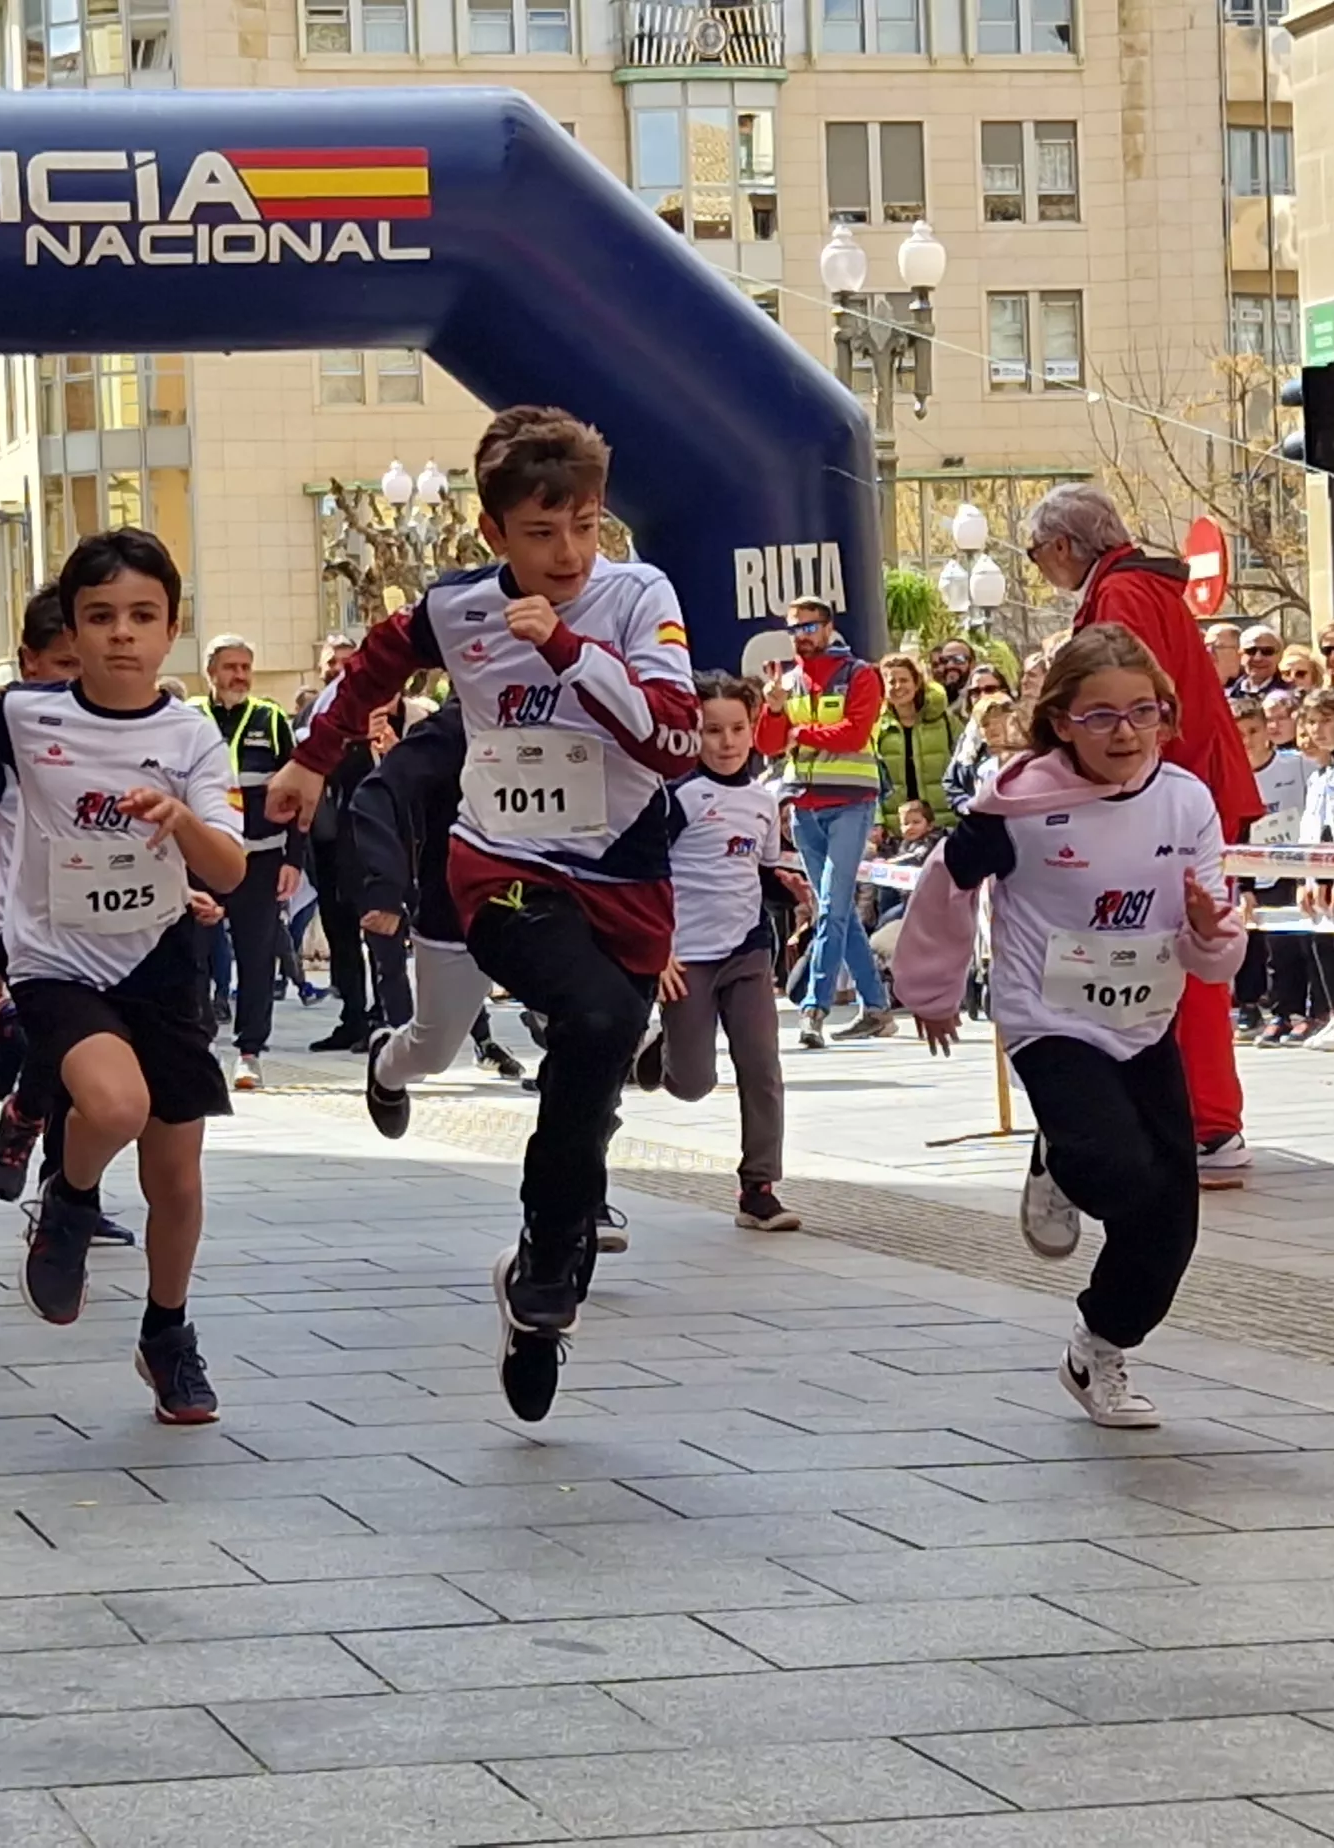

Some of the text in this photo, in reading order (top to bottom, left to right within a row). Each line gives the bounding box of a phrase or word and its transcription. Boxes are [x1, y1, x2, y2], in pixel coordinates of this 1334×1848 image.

[25, 219, 432, 267] NACIONAL
[733, 542, 847, 620] RUTA
[493, 787, 566, 813] 1011
[85, 883, 155, 913] 1025
[1081, 982, 1152, 1007] 1010
